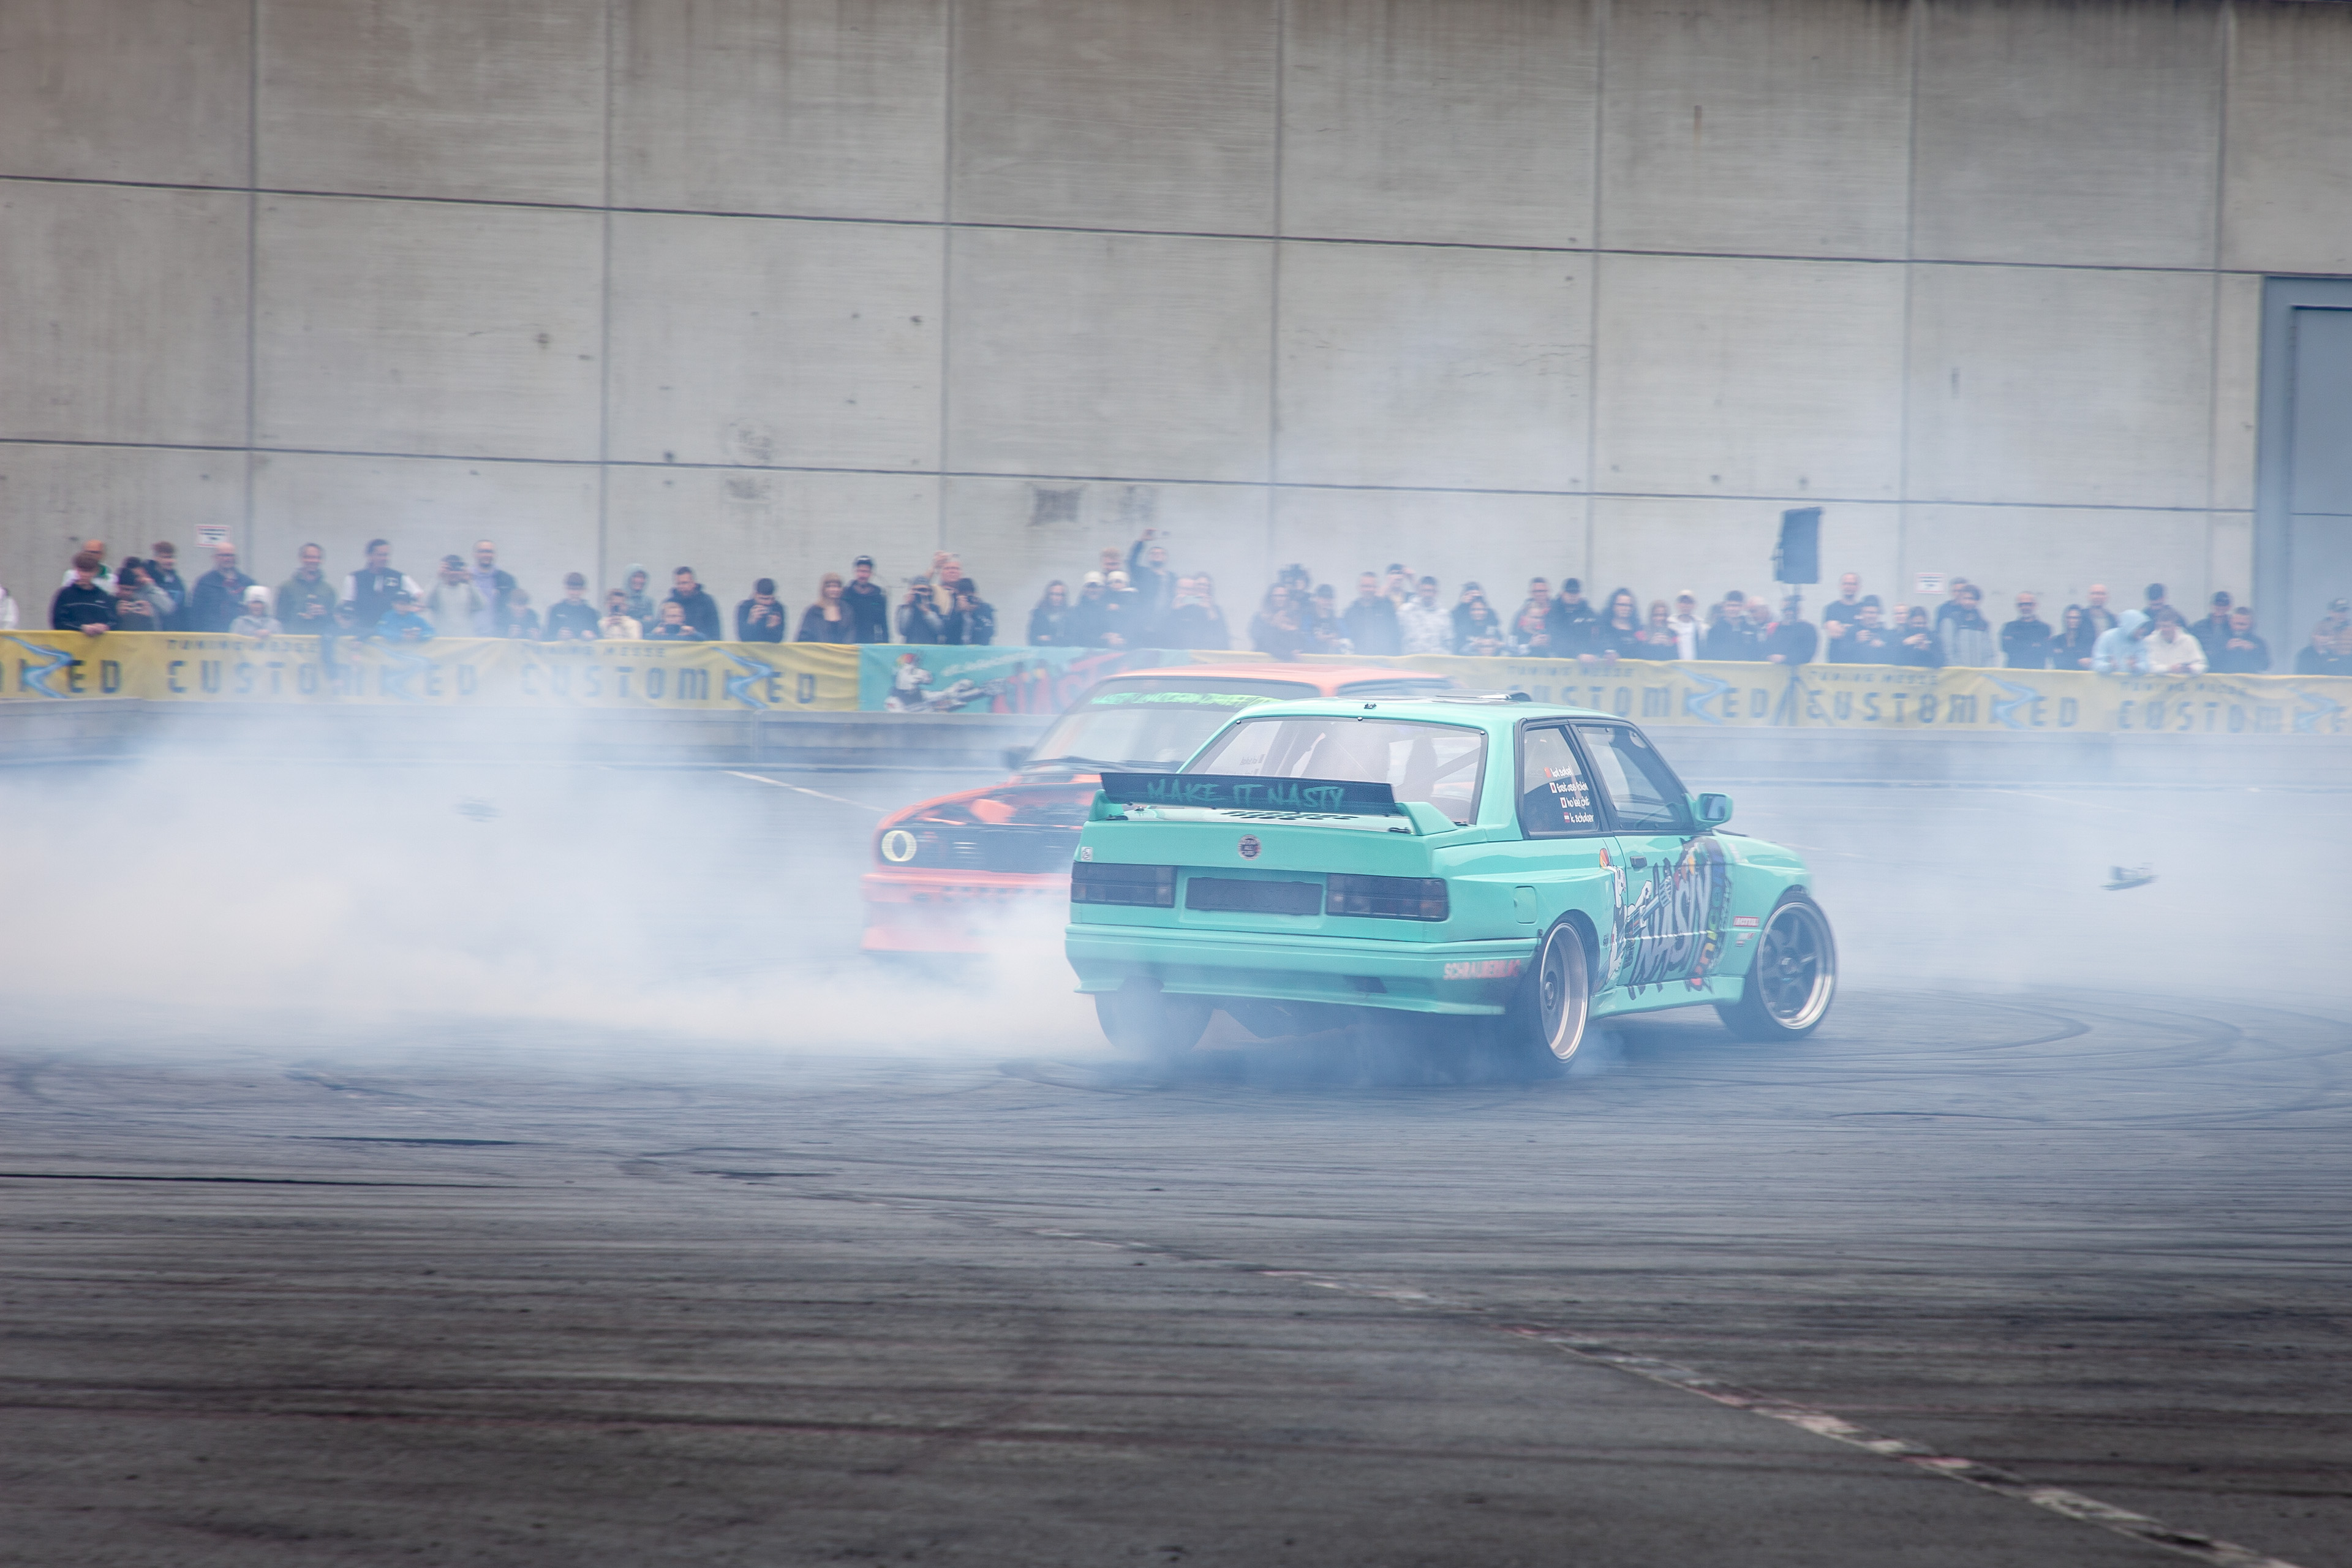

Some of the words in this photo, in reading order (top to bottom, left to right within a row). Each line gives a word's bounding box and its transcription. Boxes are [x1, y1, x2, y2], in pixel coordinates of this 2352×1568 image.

[1147, 778, 1225, 802] MAKE
[1232, 783, 1266, 807] IT
[1267, 782, 1346, 811] NASTY
